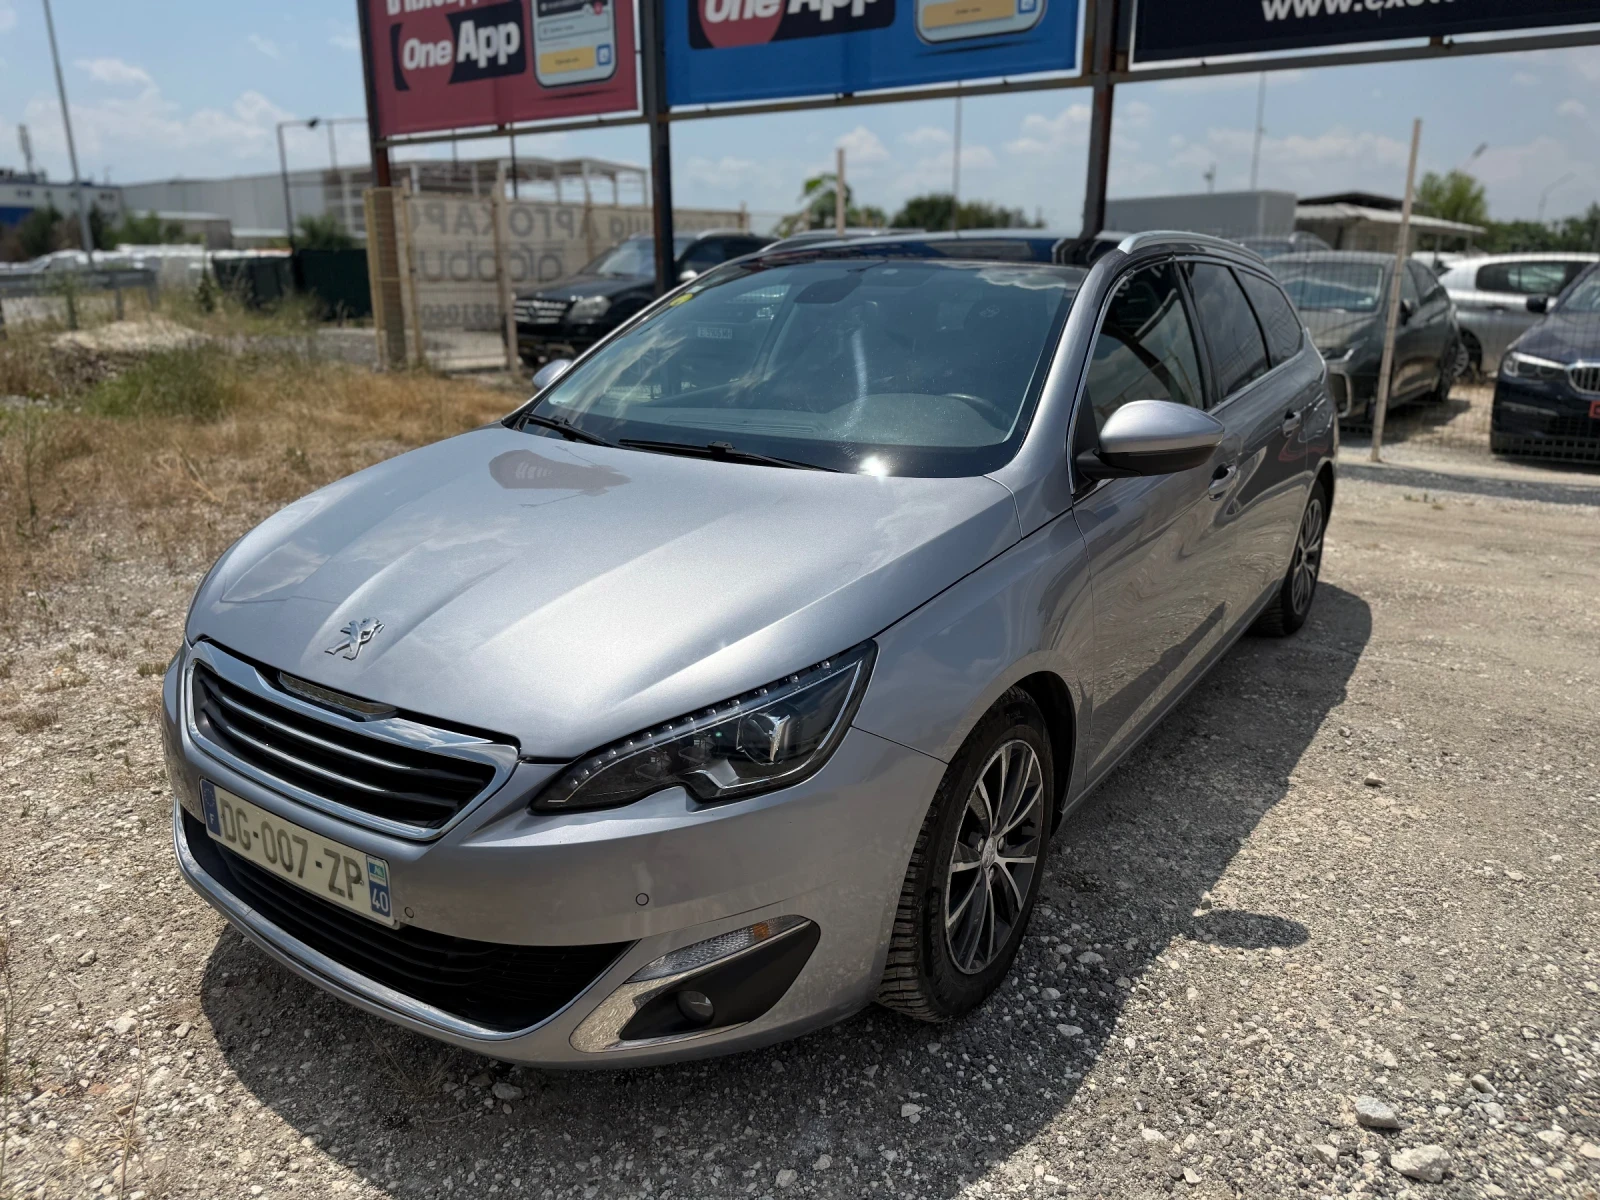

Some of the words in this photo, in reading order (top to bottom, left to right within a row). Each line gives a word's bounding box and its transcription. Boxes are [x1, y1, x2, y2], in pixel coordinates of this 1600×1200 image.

[402, 38, 453, 70] One
[456, 19, 521, 69] App
[209, 813, 215, 825] F
[219, 797, 364, 901] DG-007-ZP
[371, 888, 389, 913] 40
